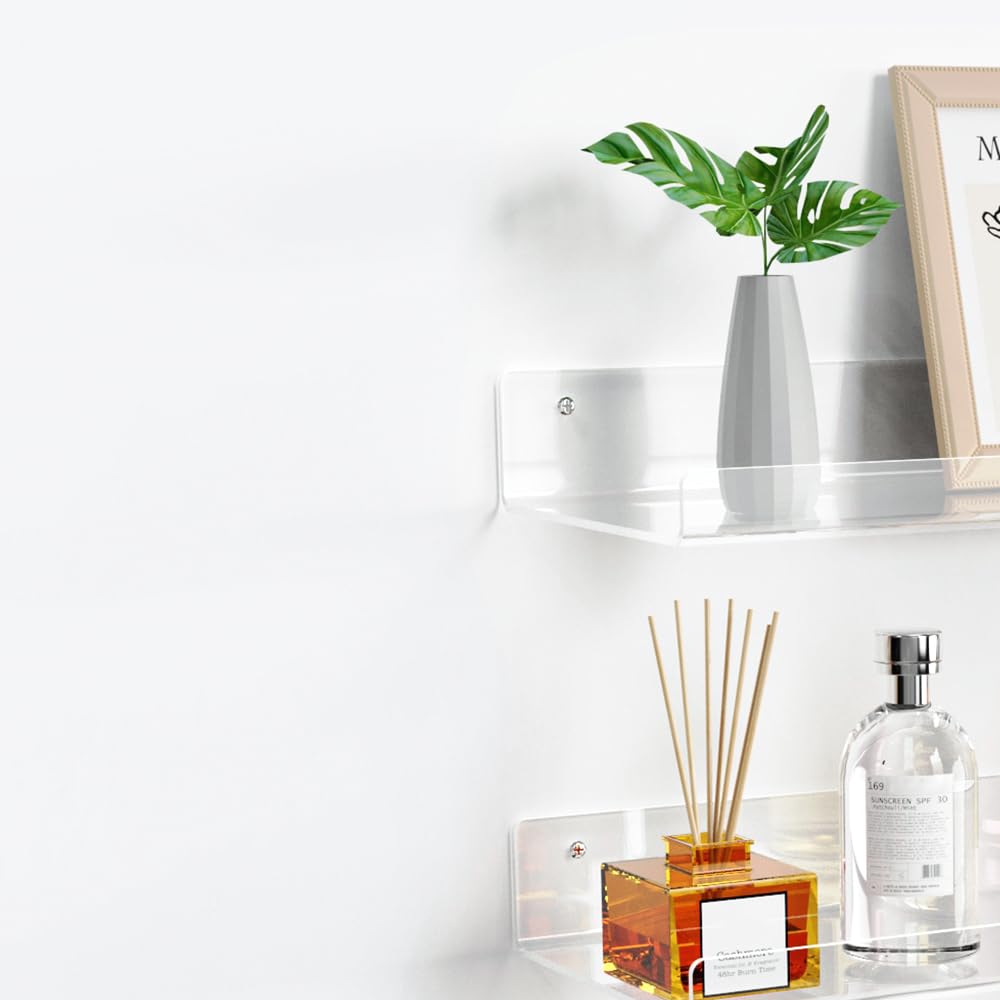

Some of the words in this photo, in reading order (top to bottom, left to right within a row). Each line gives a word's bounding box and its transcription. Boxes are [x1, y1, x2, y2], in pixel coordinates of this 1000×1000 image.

[867, 781, 884, 791] 169
[871, 796, 912, 805] SUNSCREEN
[916, 797, 931, 805] SPF
[938, 795, 948, 803] 30
